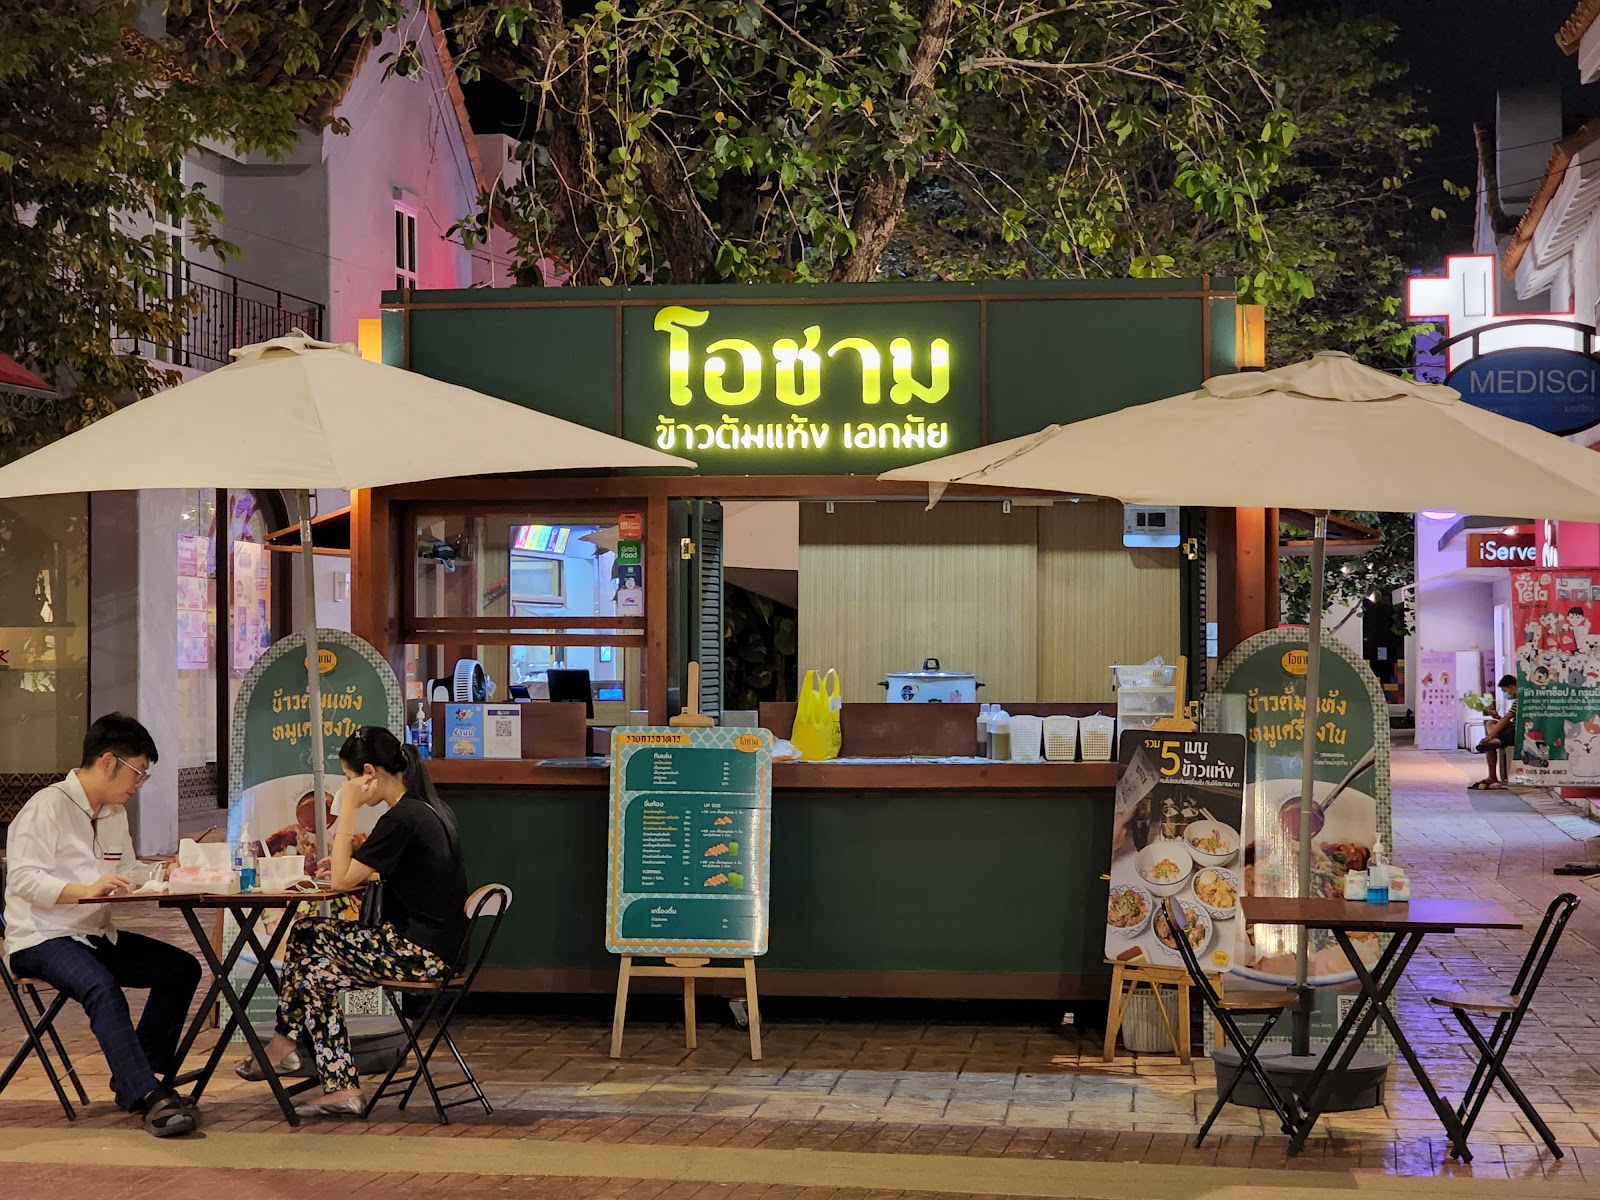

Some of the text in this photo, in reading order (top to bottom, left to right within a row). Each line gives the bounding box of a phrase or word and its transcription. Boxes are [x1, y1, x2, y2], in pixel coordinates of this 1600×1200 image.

[654, 305, 949, 406] โอชาม
[1470, 370, 1595, 393] MEDISCI
[656, 413, 948, 450] ข้าวต้มแห้ง เอกมัย
[1480, 541, 1536, 560] iServe
[1144, 739, 1208, 776] รวม 5 เมนู
[1182, 758, 1235, 779] ข้าวแห้ง
